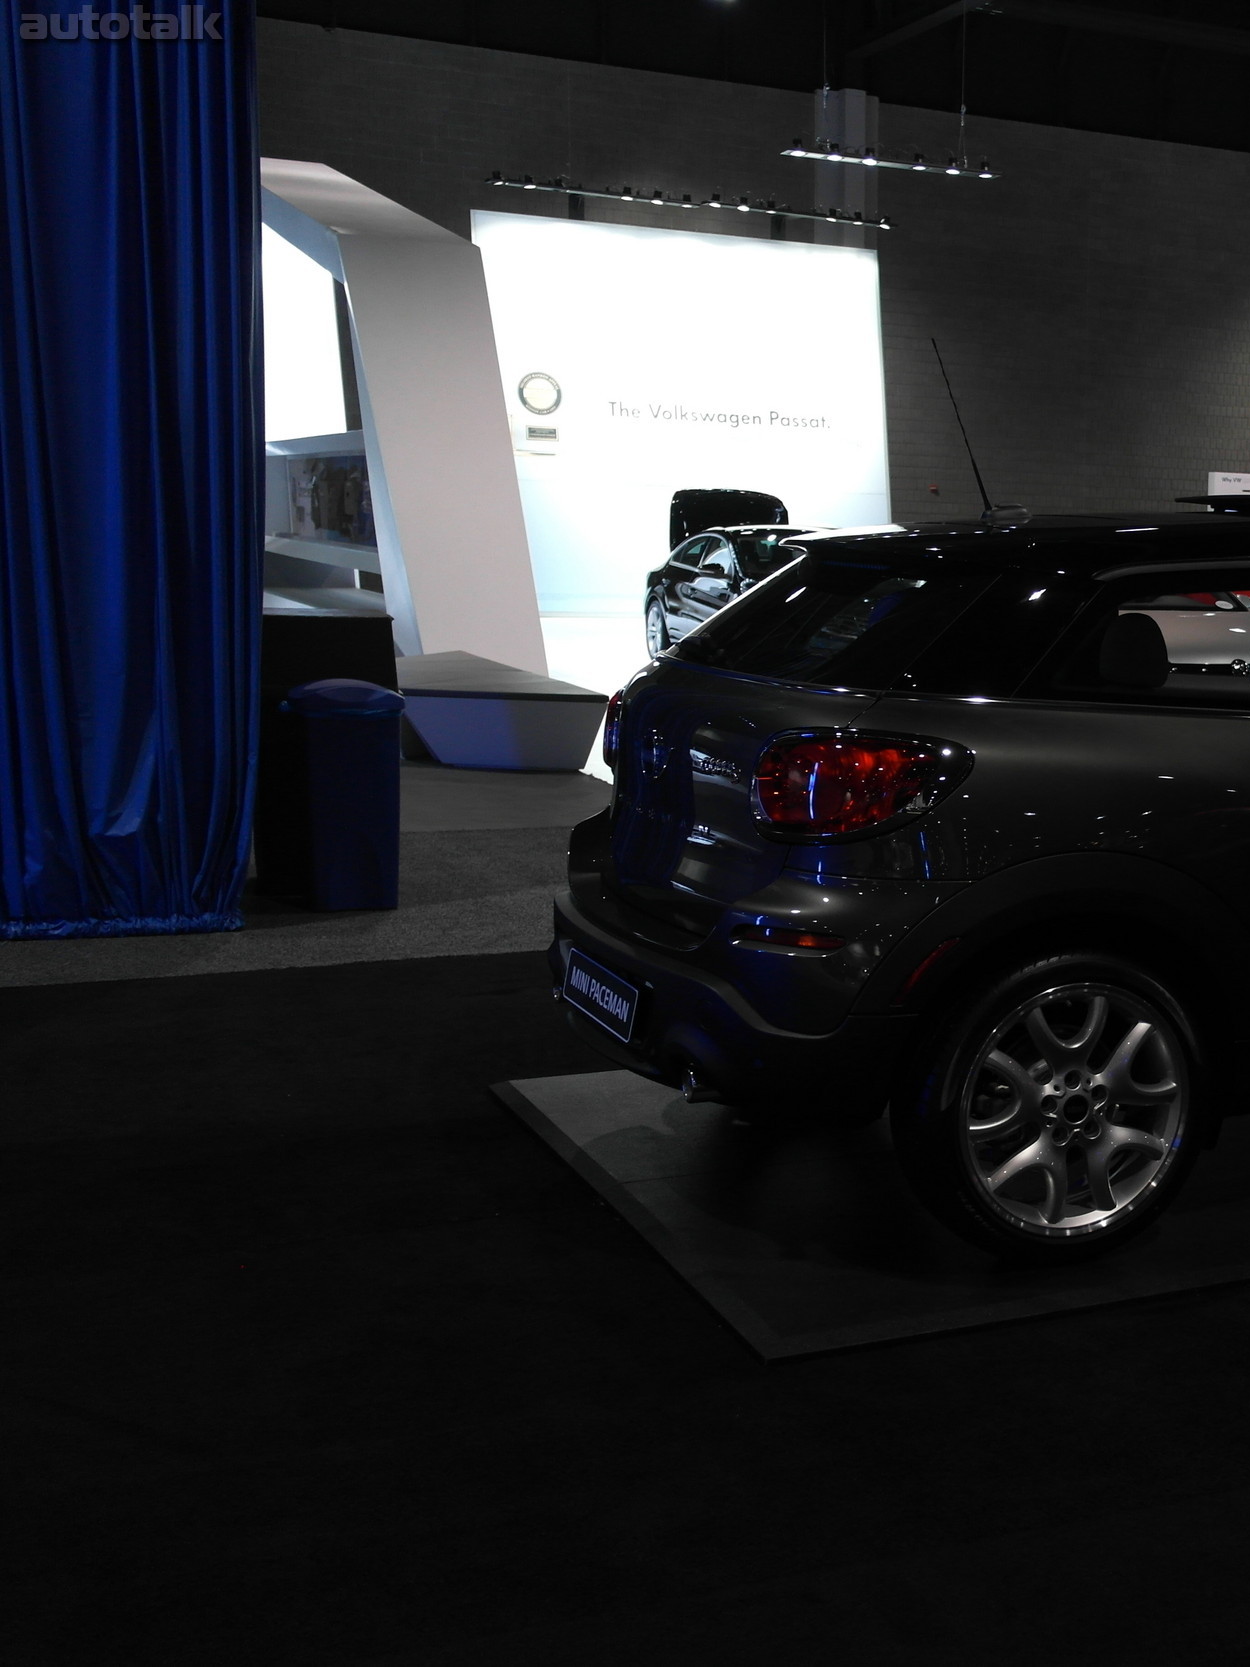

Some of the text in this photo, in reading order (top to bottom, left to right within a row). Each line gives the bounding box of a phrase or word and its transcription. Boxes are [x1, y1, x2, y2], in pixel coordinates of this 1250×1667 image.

[608, 401, 831, 429] The Volkswagen Passat.
[570, 966, 629, 1023] MINI PACEMAN
